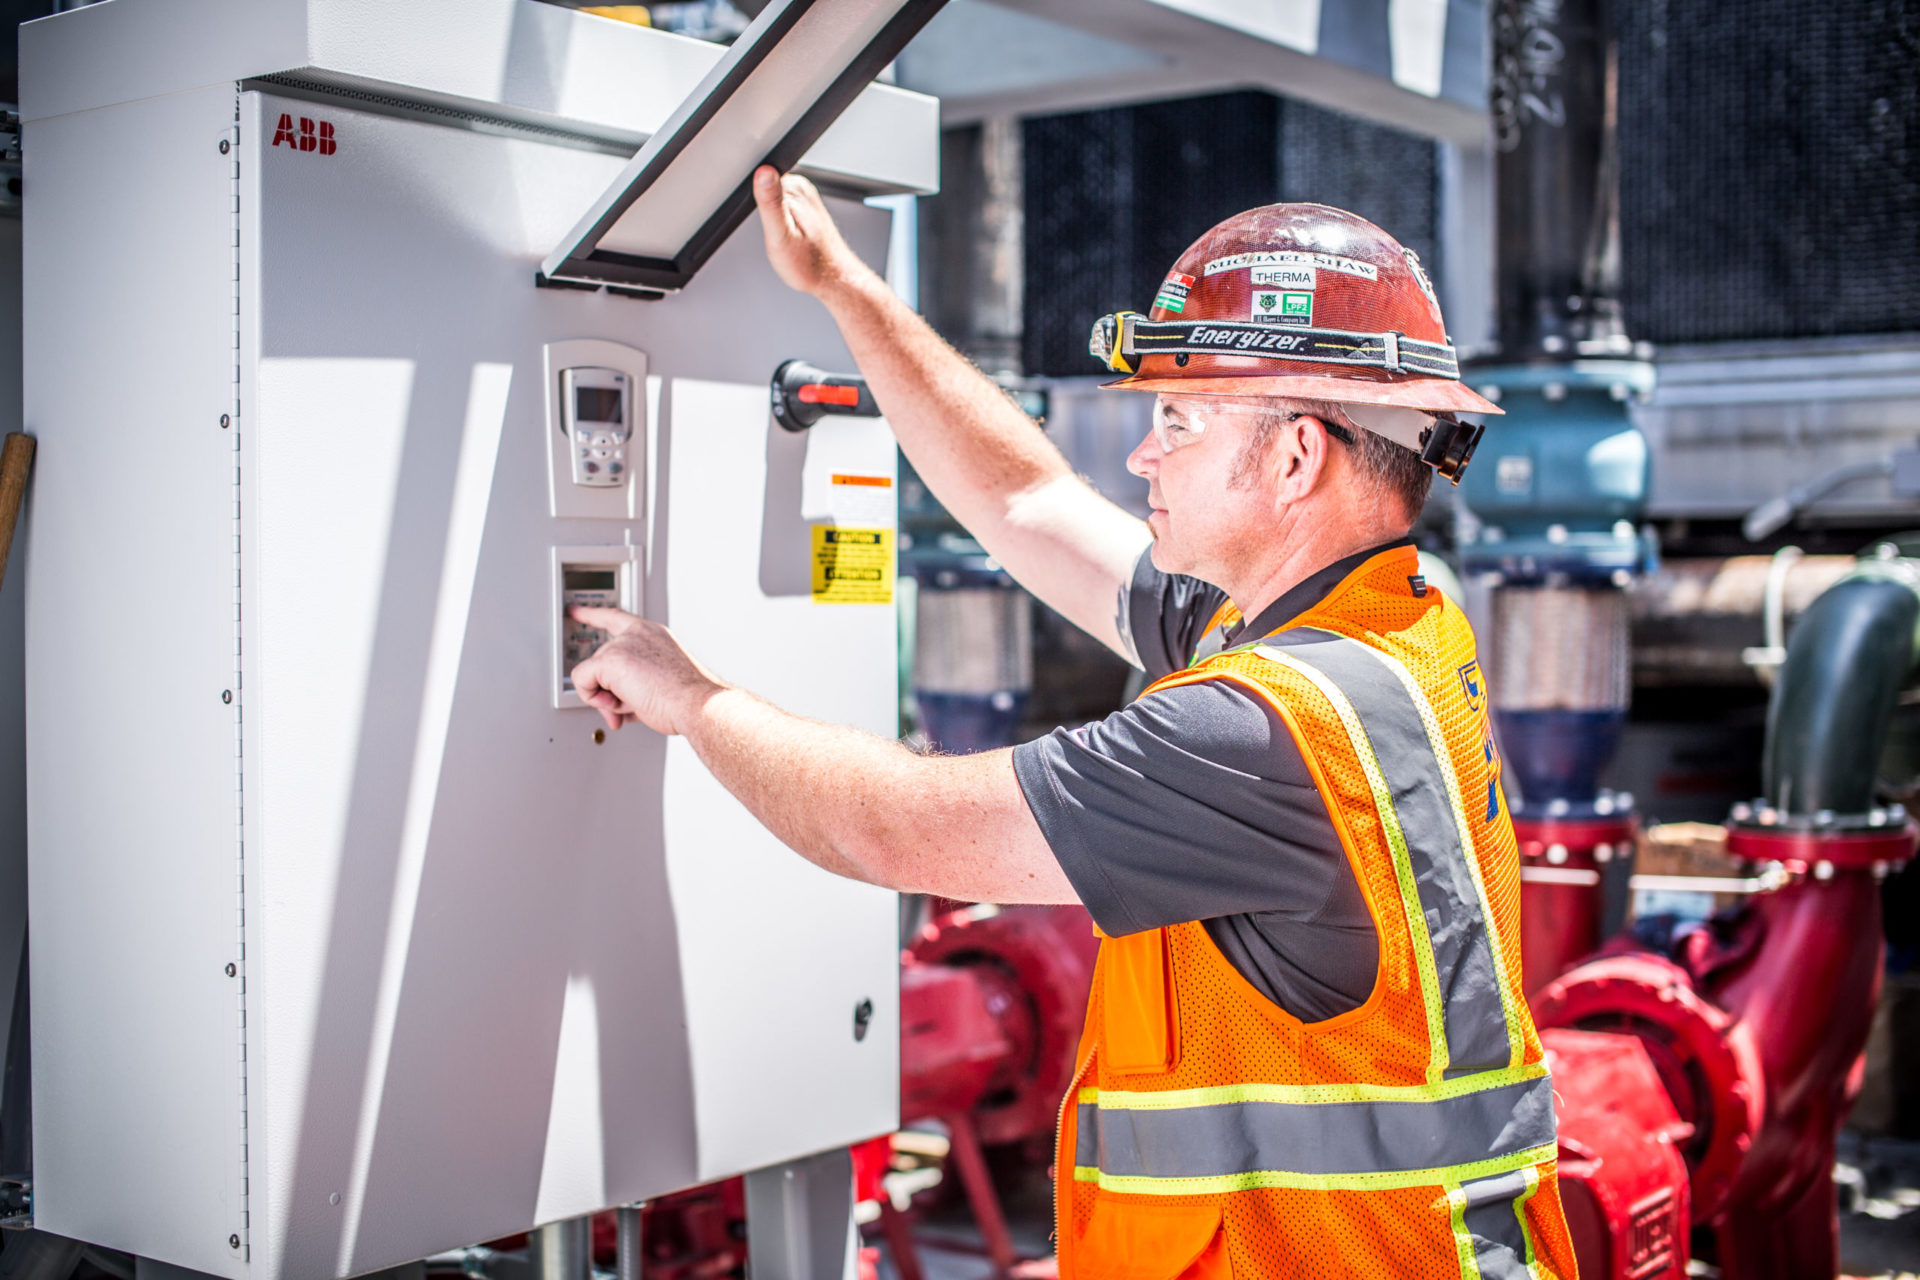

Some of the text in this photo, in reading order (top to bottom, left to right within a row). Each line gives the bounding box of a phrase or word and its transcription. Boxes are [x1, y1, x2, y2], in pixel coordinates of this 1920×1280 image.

[272, 113, 337, 156] ABB
[1313, 256, 1375, 274] SHAW
[1256, 272, 1311, 282] THERMA
